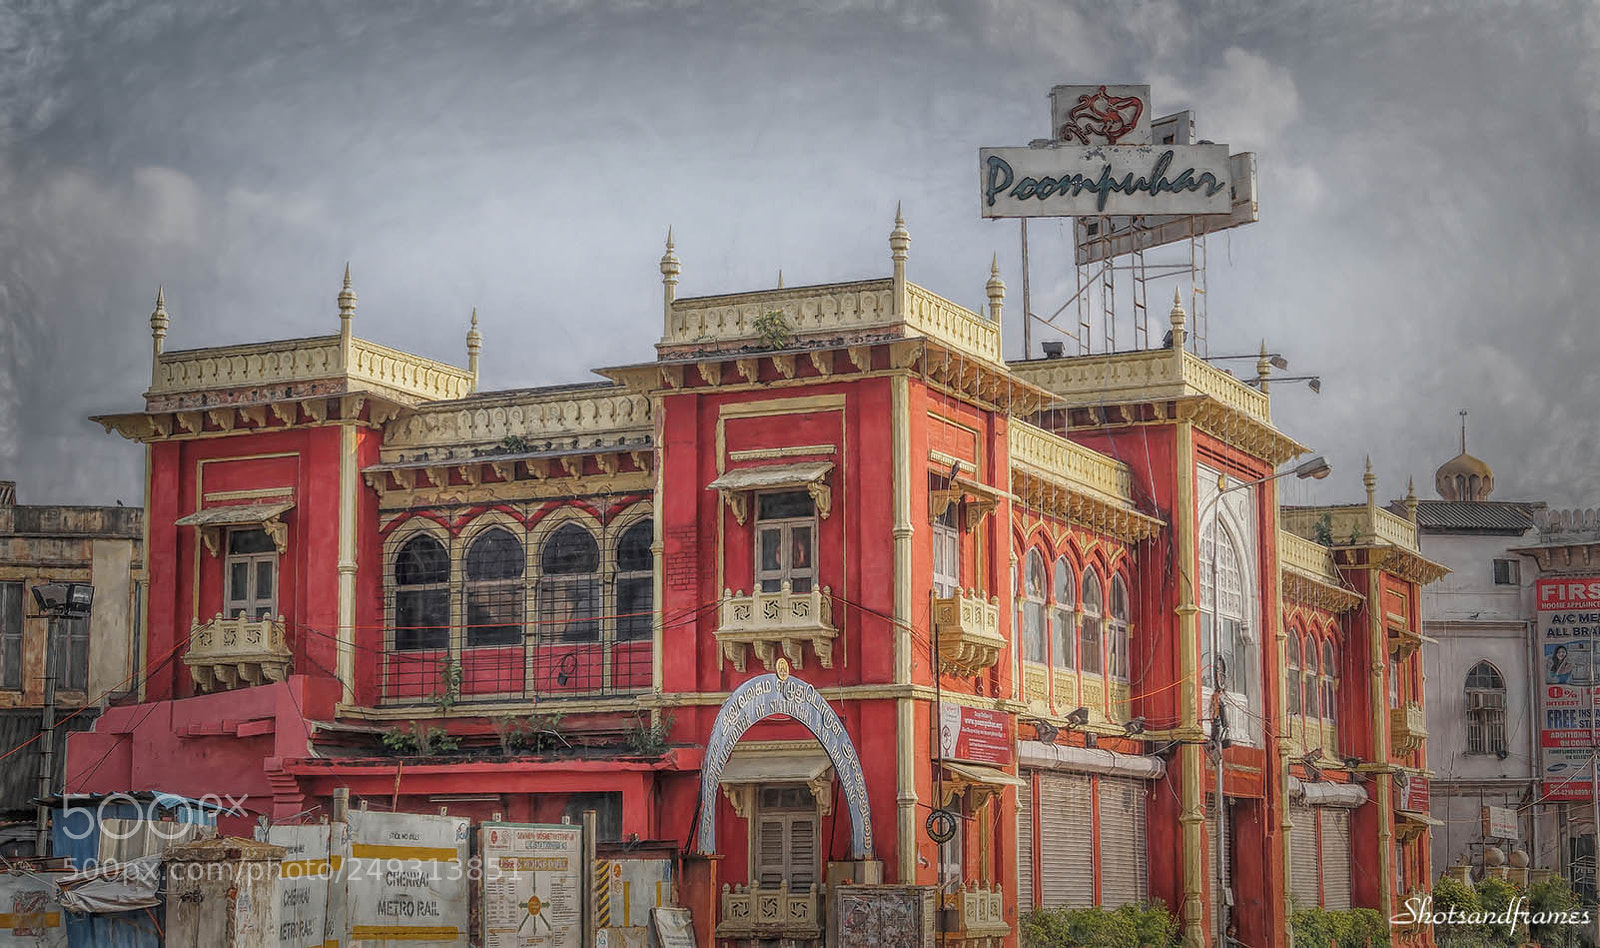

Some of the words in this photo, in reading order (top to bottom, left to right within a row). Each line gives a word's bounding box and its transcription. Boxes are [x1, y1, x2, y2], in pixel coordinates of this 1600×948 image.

[985, 150, 1225, 212] Poompuhar
[1552, 613, 1575, 624] A/C
[1546, 628, 1571, 638] ALL
[1572, 627, 1600, 637] BRA
[377, 900, 415, 918] METRO
